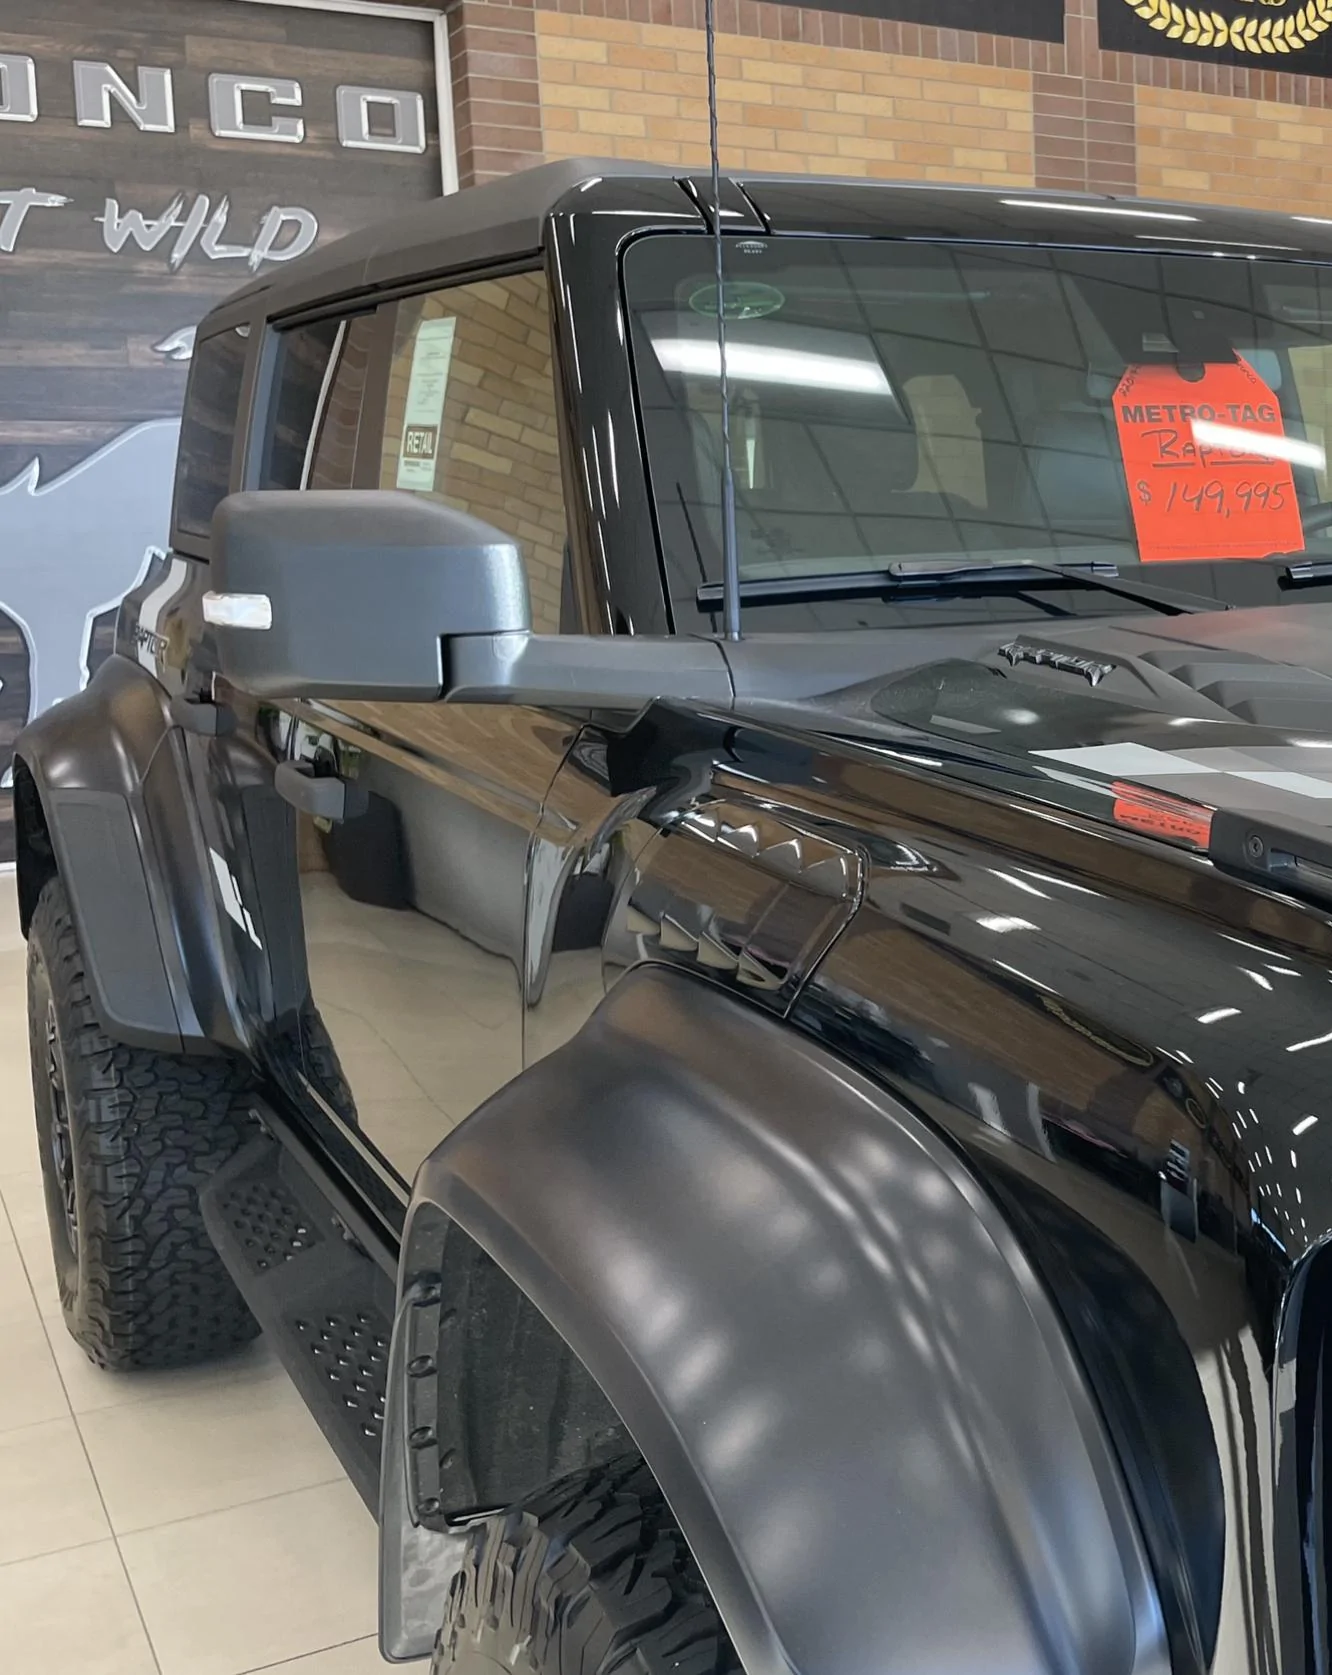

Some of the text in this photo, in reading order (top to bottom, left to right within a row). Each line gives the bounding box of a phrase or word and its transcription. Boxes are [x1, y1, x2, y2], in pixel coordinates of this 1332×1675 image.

[94, 193, 319, 273] WILD
[1121, 404, 1276, 424] METRO-TAG
[407, 431, 433, 454] RETAIL
[1137, 480, 1292, 519] $ 149,995
